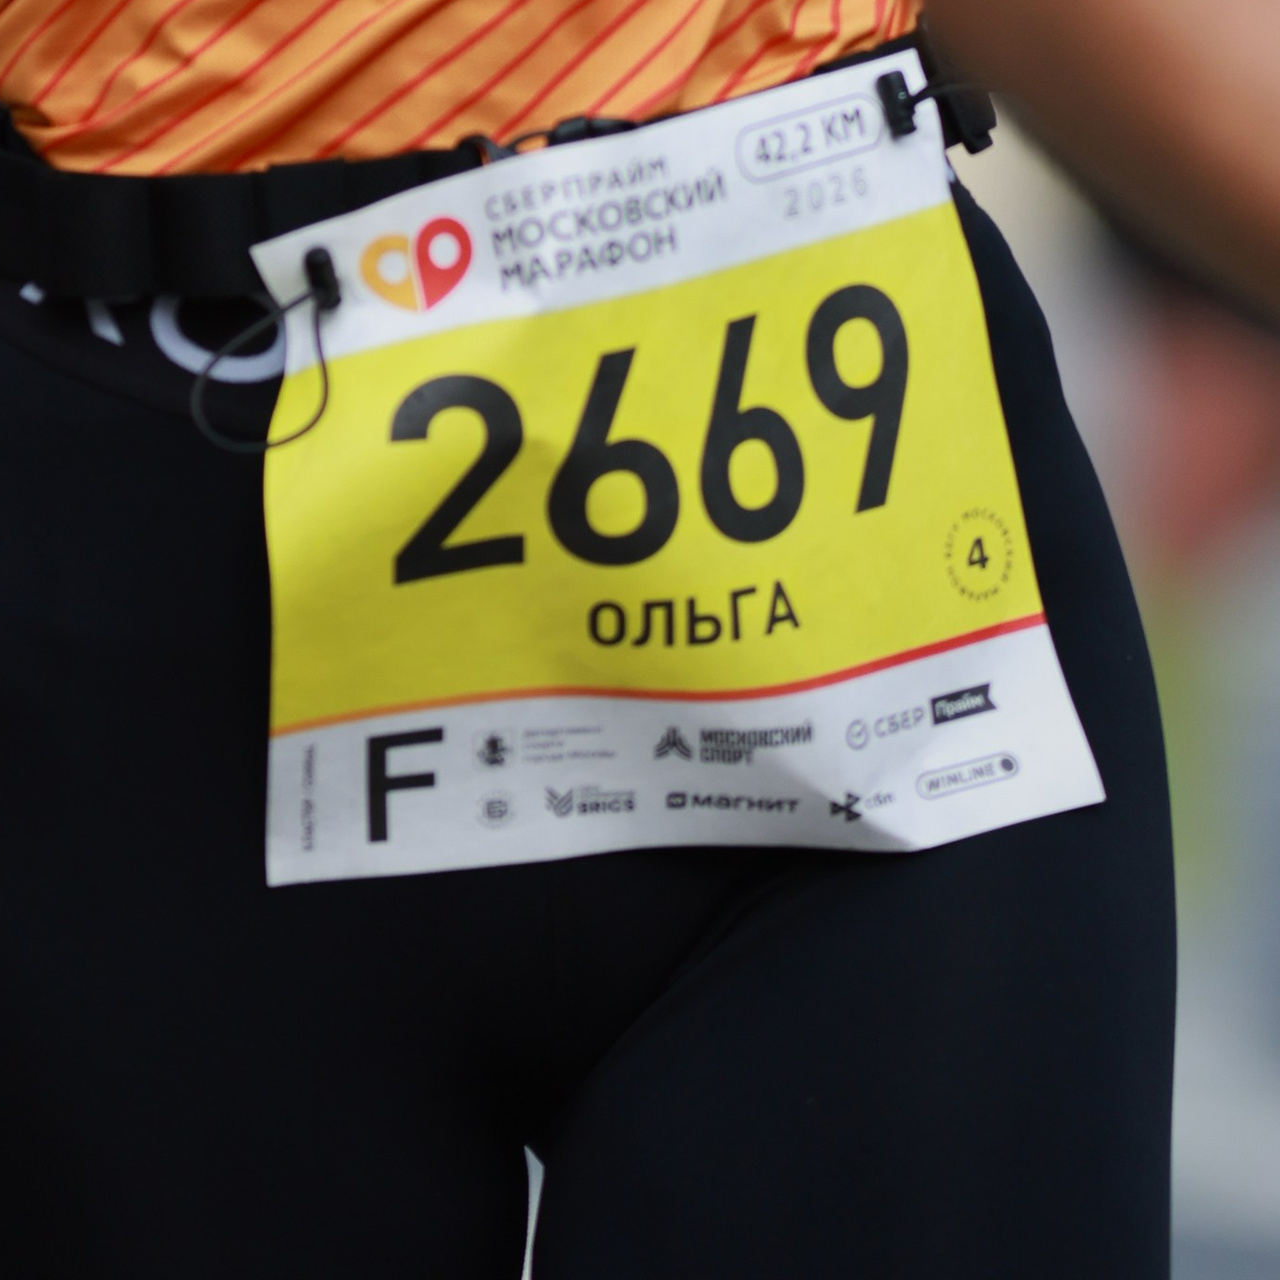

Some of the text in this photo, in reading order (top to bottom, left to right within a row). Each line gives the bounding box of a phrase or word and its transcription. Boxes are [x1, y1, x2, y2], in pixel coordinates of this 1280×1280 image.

[491, 168, 726, 257] МОСКОВСКИЙ
[784, 168, 866, 218] 2026
[500, 226, 677, 291] МАРАФОН
[390, 283, 909, 586] 2669
[968, 537, 989, 569] 4
[588, 580, 800, 647] ОЛЬГА
[874, 707, 924, 737] СБЕР
[368, 727, 443, 842] F
[578, 798, 634, 814] BRICS
